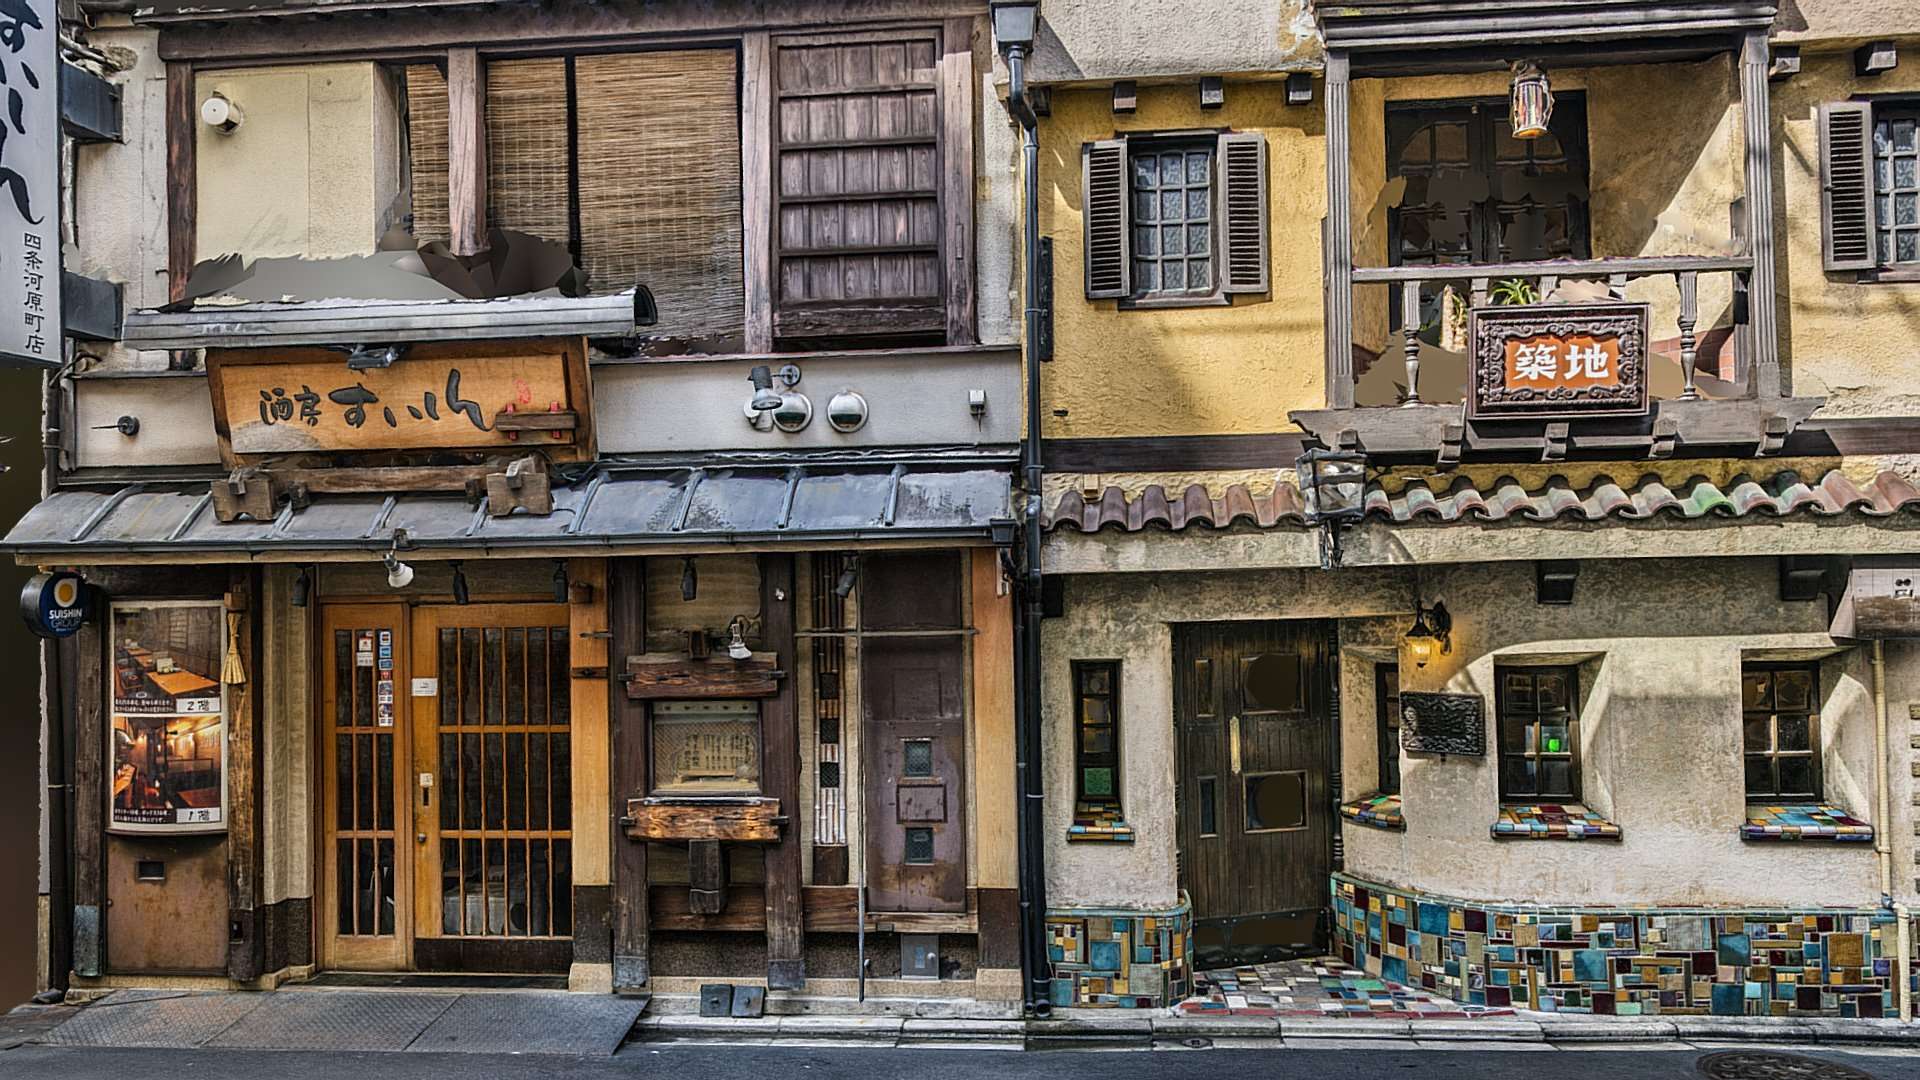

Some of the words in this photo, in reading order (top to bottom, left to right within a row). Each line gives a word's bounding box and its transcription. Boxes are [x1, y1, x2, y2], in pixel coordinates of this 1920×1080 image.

[23, 232, 45, 354] 四条河原町店
[1513, 343, 1609, 381] 築地
[48, 608, 82, 619] SUISHIN
